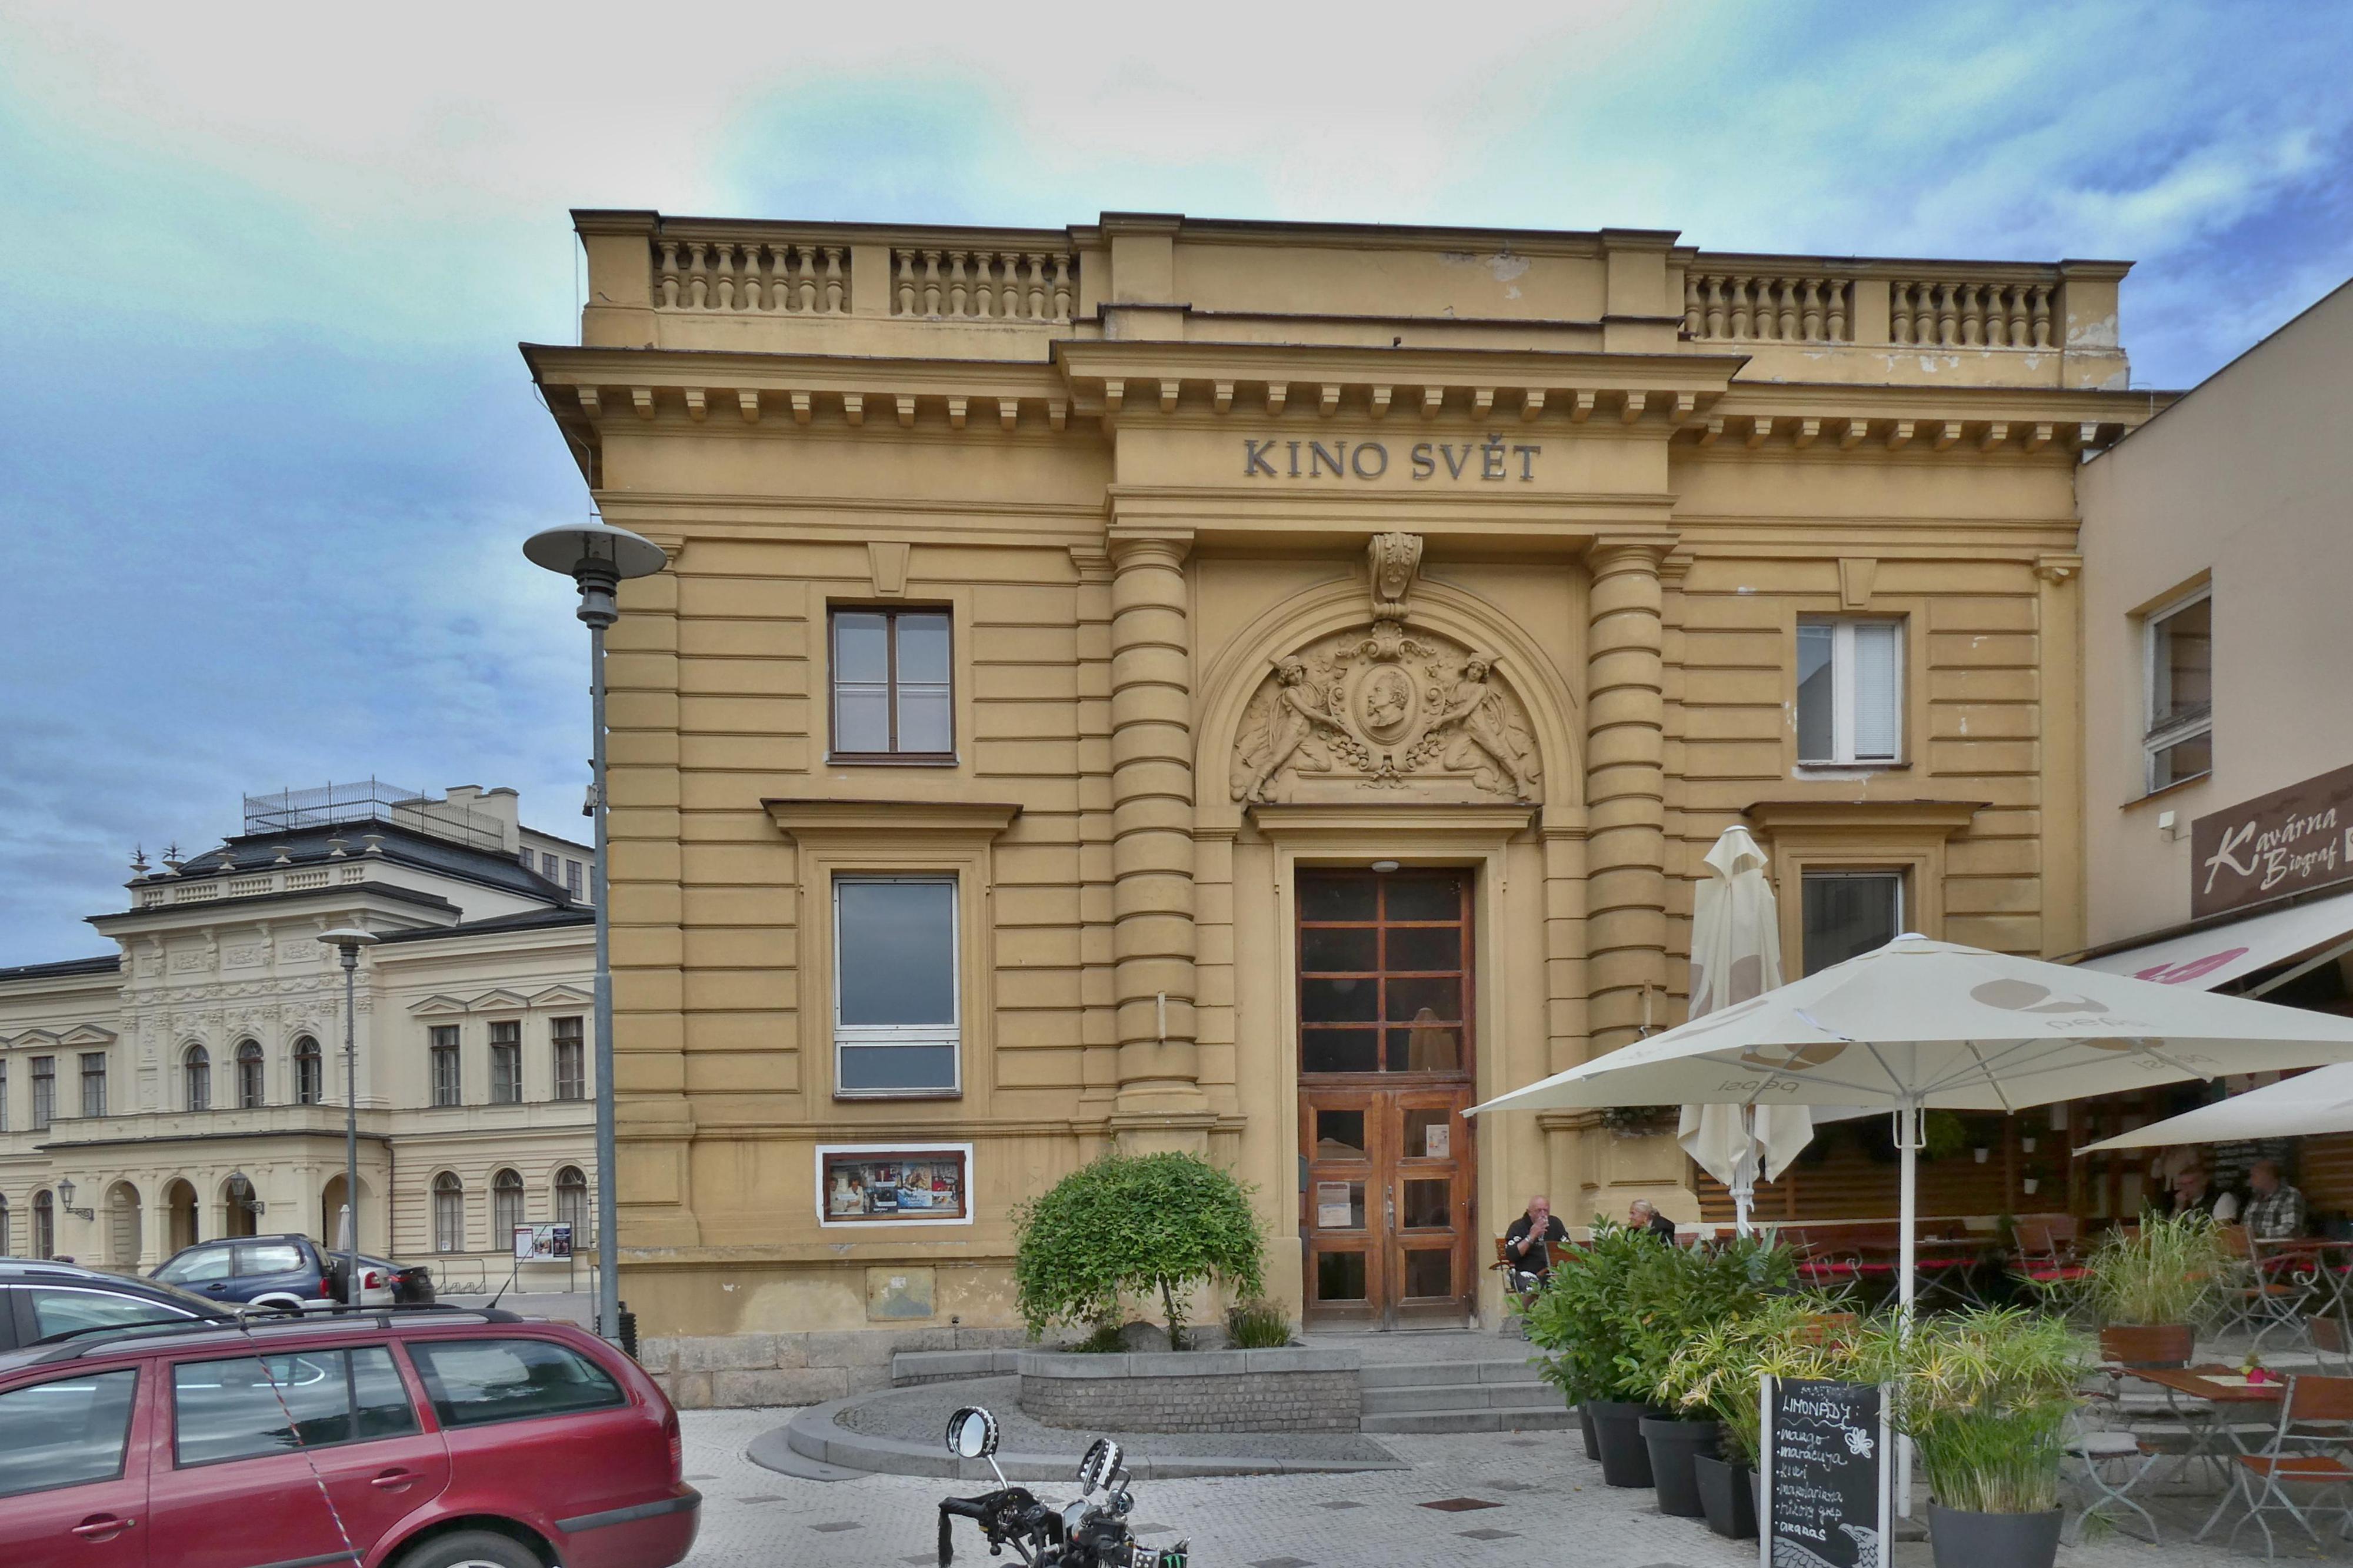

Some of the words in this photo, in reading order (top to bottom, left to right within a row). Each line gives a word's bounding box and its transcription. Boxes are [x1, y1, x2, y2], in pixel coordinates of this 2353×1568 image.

[1244, 439, 1388, 481] KINO
[1411, 432, 1541, 481] SVĚT
[2204, 808, 2338, 894] Kavárna
[2260, 838, 2338, 890] Biograf
[1779, 1446, 1848, 1472] maracuya
